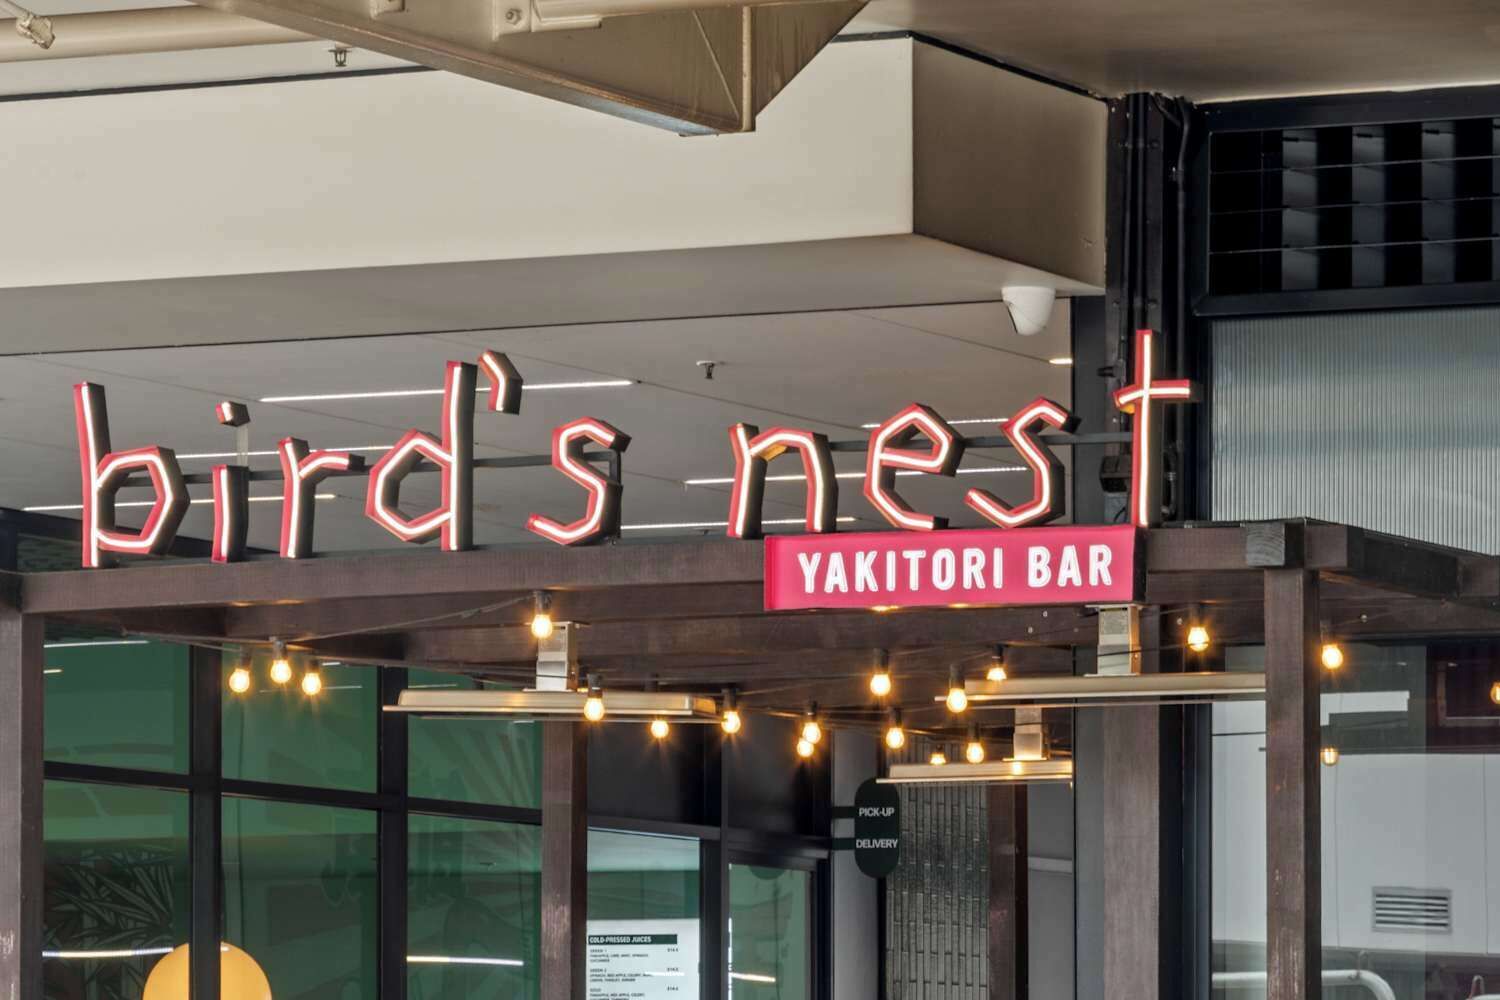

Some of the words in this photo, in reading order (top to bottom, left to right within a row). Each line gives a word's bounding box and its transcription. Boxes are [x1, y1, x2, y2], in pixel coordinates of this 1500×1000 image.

[73, 350, 632, 568] bird's
[727, 329, 1198, 539] nest
[796, 546, 1004, 594] YAKITORI
[1027, 543, 1113, 589] BAR
[858, 807, 895, 817] PICK-UP
[855, 838, 898, 849] DELIVERY
[589, 935, 631, 944] COLD-PRESSED
[631, 935, 652, 944] JUICES
